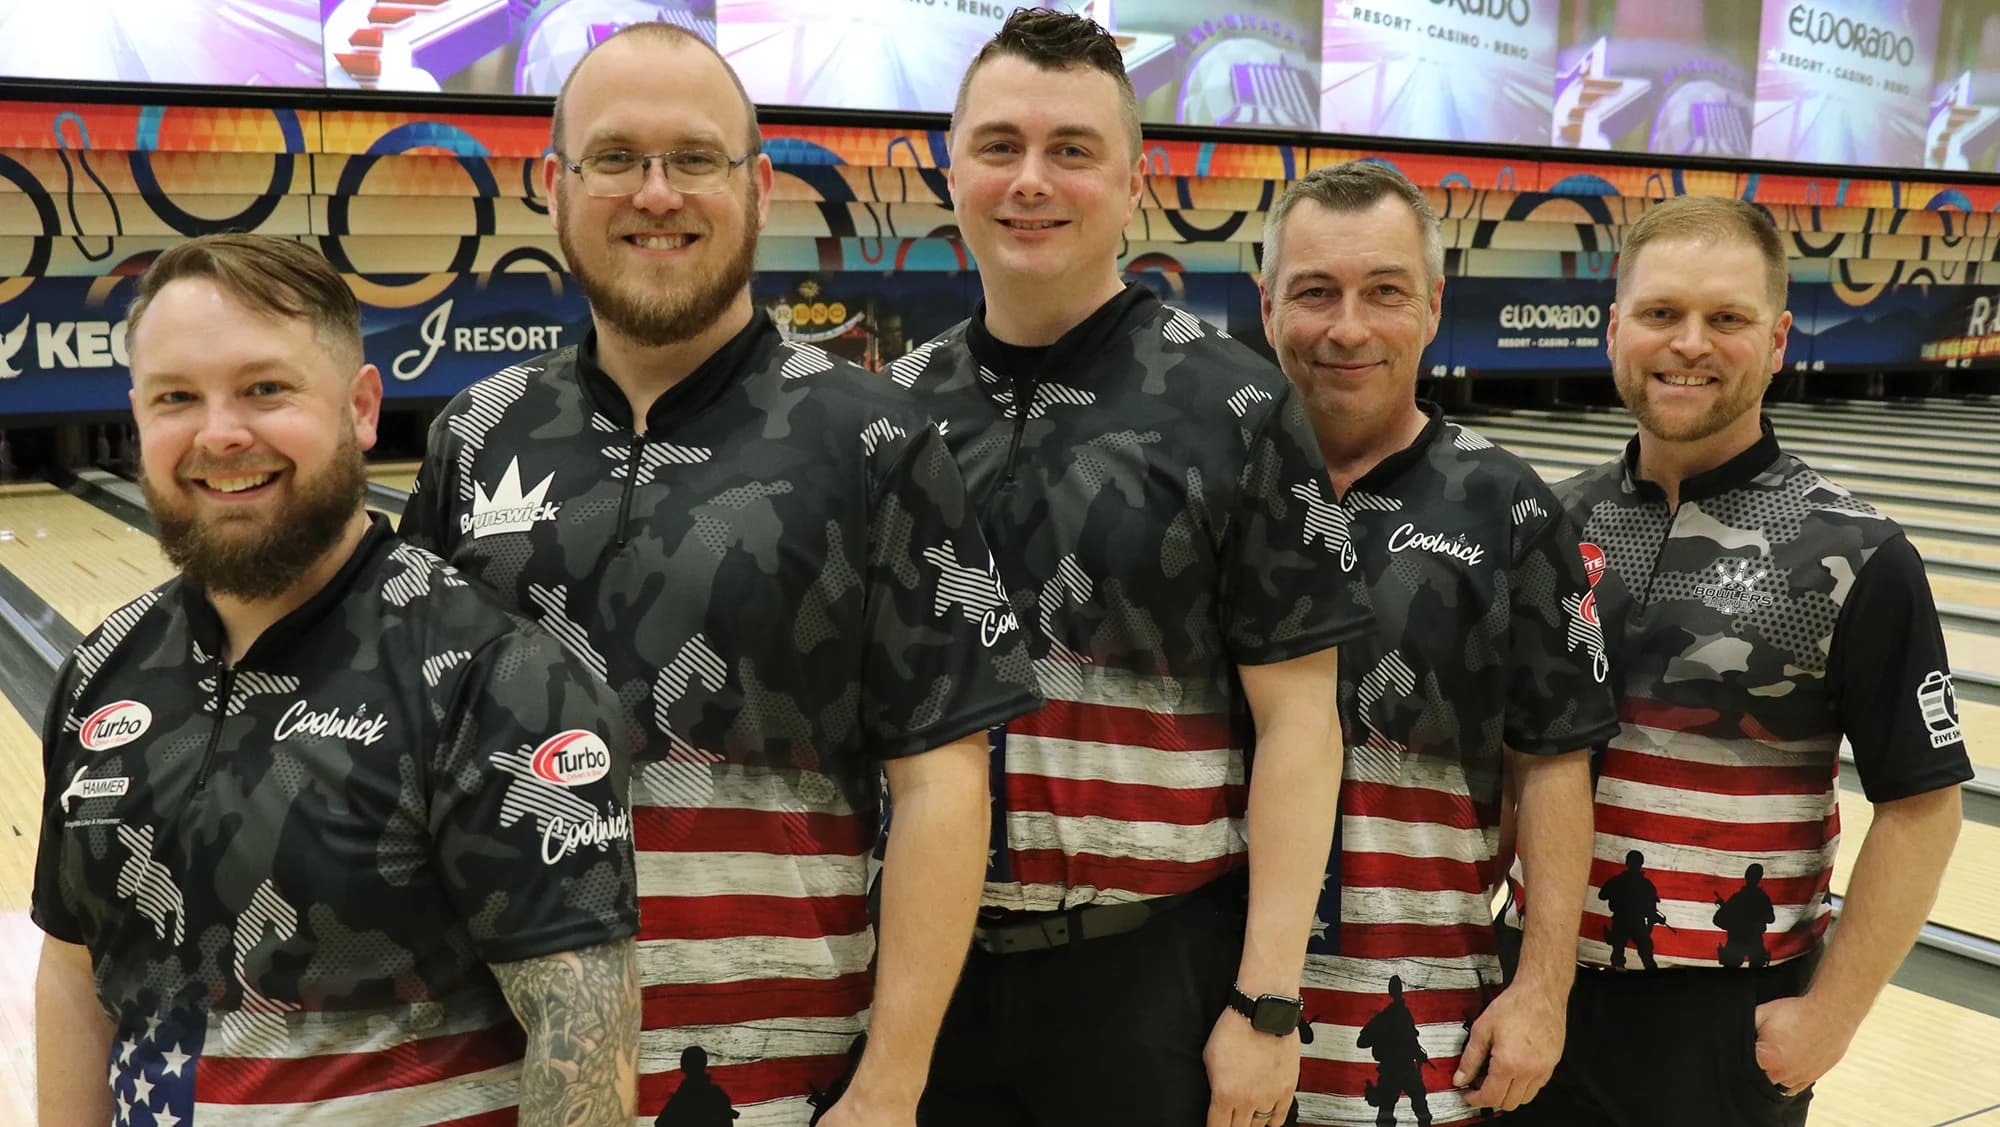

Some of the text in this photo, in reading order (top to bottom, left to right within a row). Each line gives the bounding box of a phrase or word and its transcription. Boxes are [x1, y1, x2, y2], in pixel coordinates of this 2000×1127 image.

[957, 1, 1005, 21] RENO
[1353, 7, 1412, 31] RESORT
[1427, 25, 1480, 48] CASINO
[1499, 304, 1600, 331] ELDORADO
[454, 326, 563, 352] RESORT
[460, 501, 561, 535] Brunswick
[1388, 522, 1485, 566] Coolwick
[1694, 584, 1773, 607] BOWLERS
[93, 716, 142, 740] Turbo
[274, 700, 389, 746] Coolwick
[1934, 732, 1952, 744] FIVE
[553, 746, 606, 775] Turbo
[82, 780, 125, 795] HAMMER
